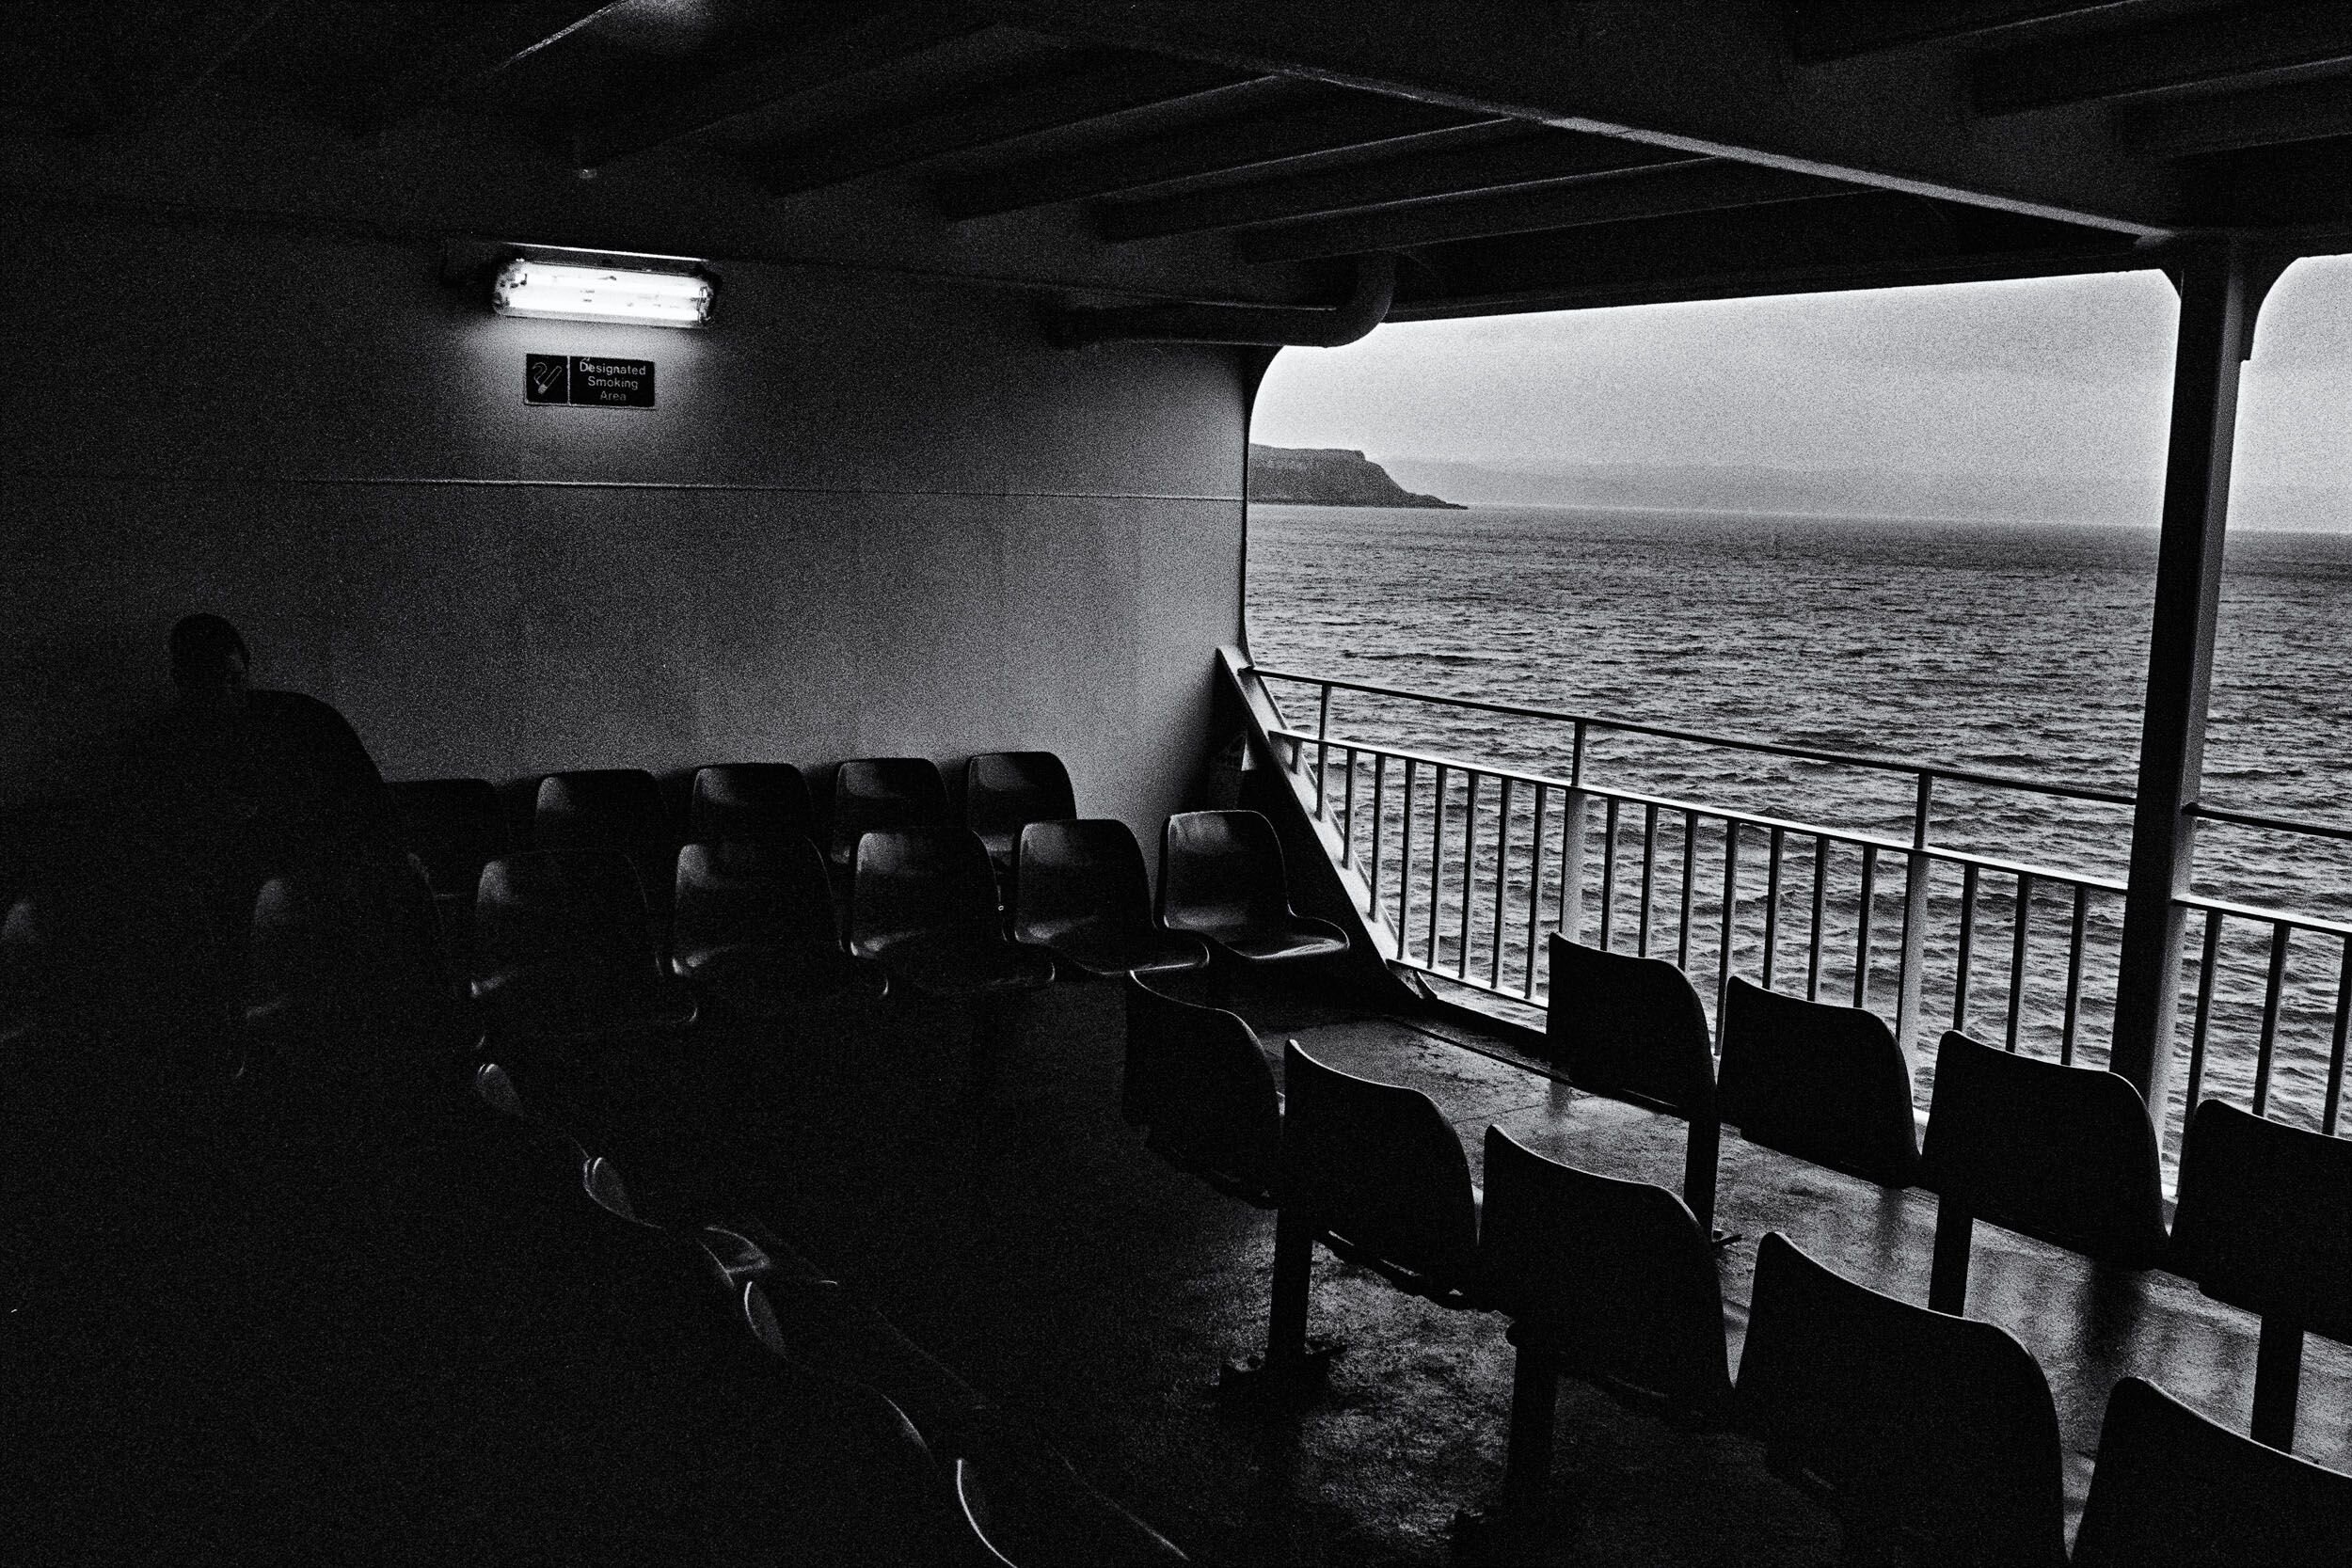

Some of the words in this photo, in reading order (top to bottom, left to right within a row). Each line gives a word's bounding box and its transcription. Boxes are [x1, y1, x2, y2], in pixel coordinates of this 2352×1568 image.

[580, 361, 646, 375] Designated
[587, 376, 639, 390] Smoking
[599, 390, 627, 402] Area
